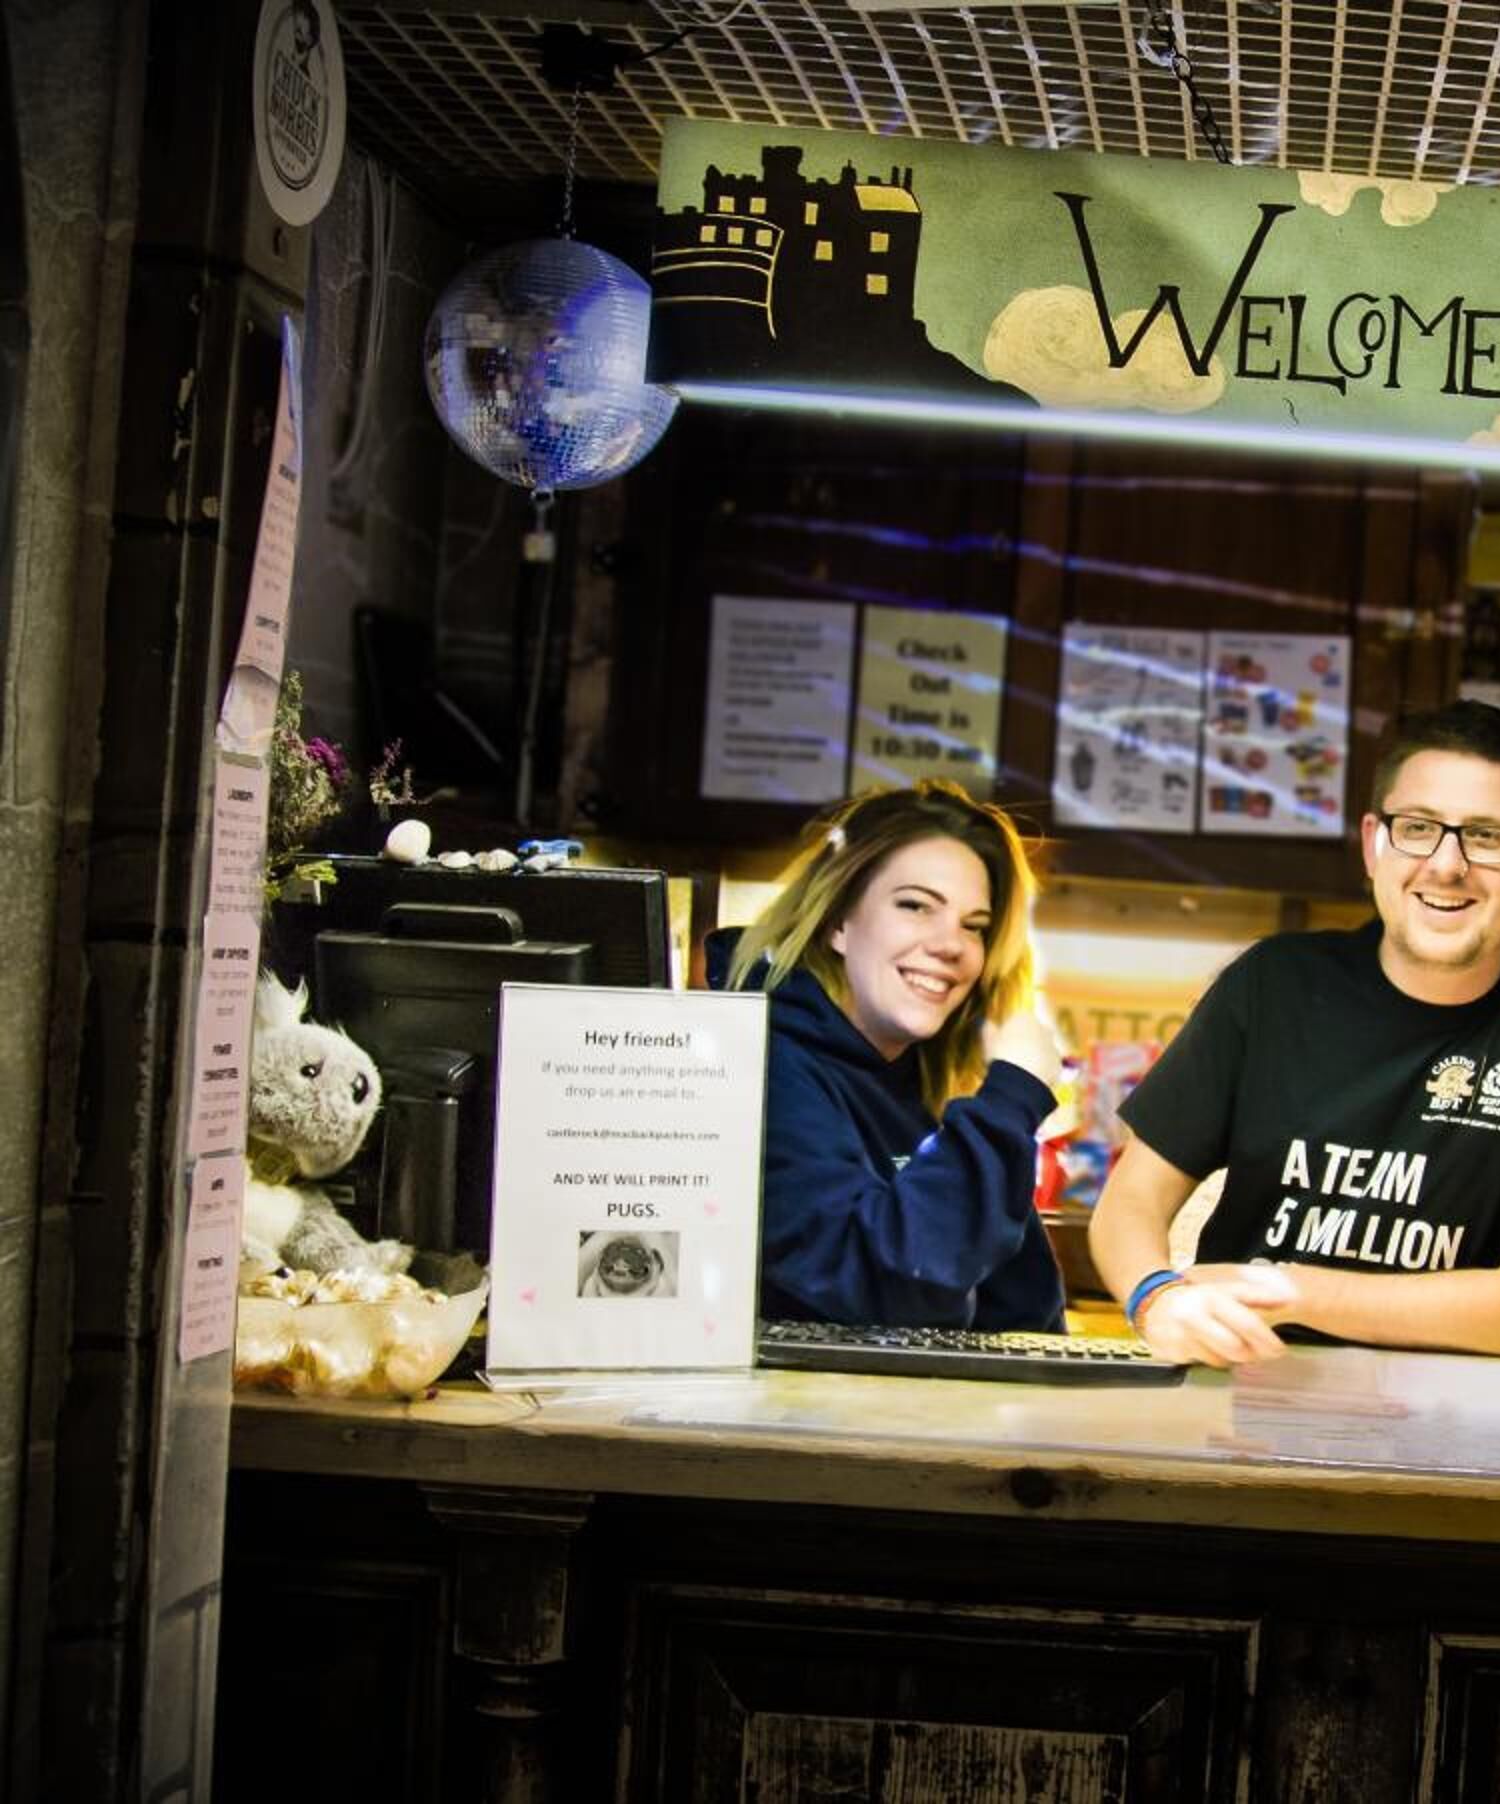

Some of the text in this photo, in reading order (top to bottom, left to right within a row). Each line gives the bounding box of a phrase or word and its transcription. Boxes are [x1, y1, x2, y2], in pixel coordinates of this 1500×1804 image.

[897, 638, 968, 662] Check
[909, 672, 951, 695] Out
[886, 703, 971, 730] Time is
[585, 1030, 692, 1050] Hey friends!
[556, 1062, 579, 1077] you
[583, 1062, 615, 1076] need
[620, 1063, 675, 1079] anything
[565, 1083, 595, 1100] drop
[553, 1172, 585, 1186] AND
[588, 1173, 609, 1186] WE
[613, 1173, 646, 1187] WILL
[649, 1174, 689, 1188] PRINT
[1281, 1138, 1428, 1207] A TEAM
[606, 1202, 661, 1219] PUGS.
[1265, 1196, 1298, 1248] 5
